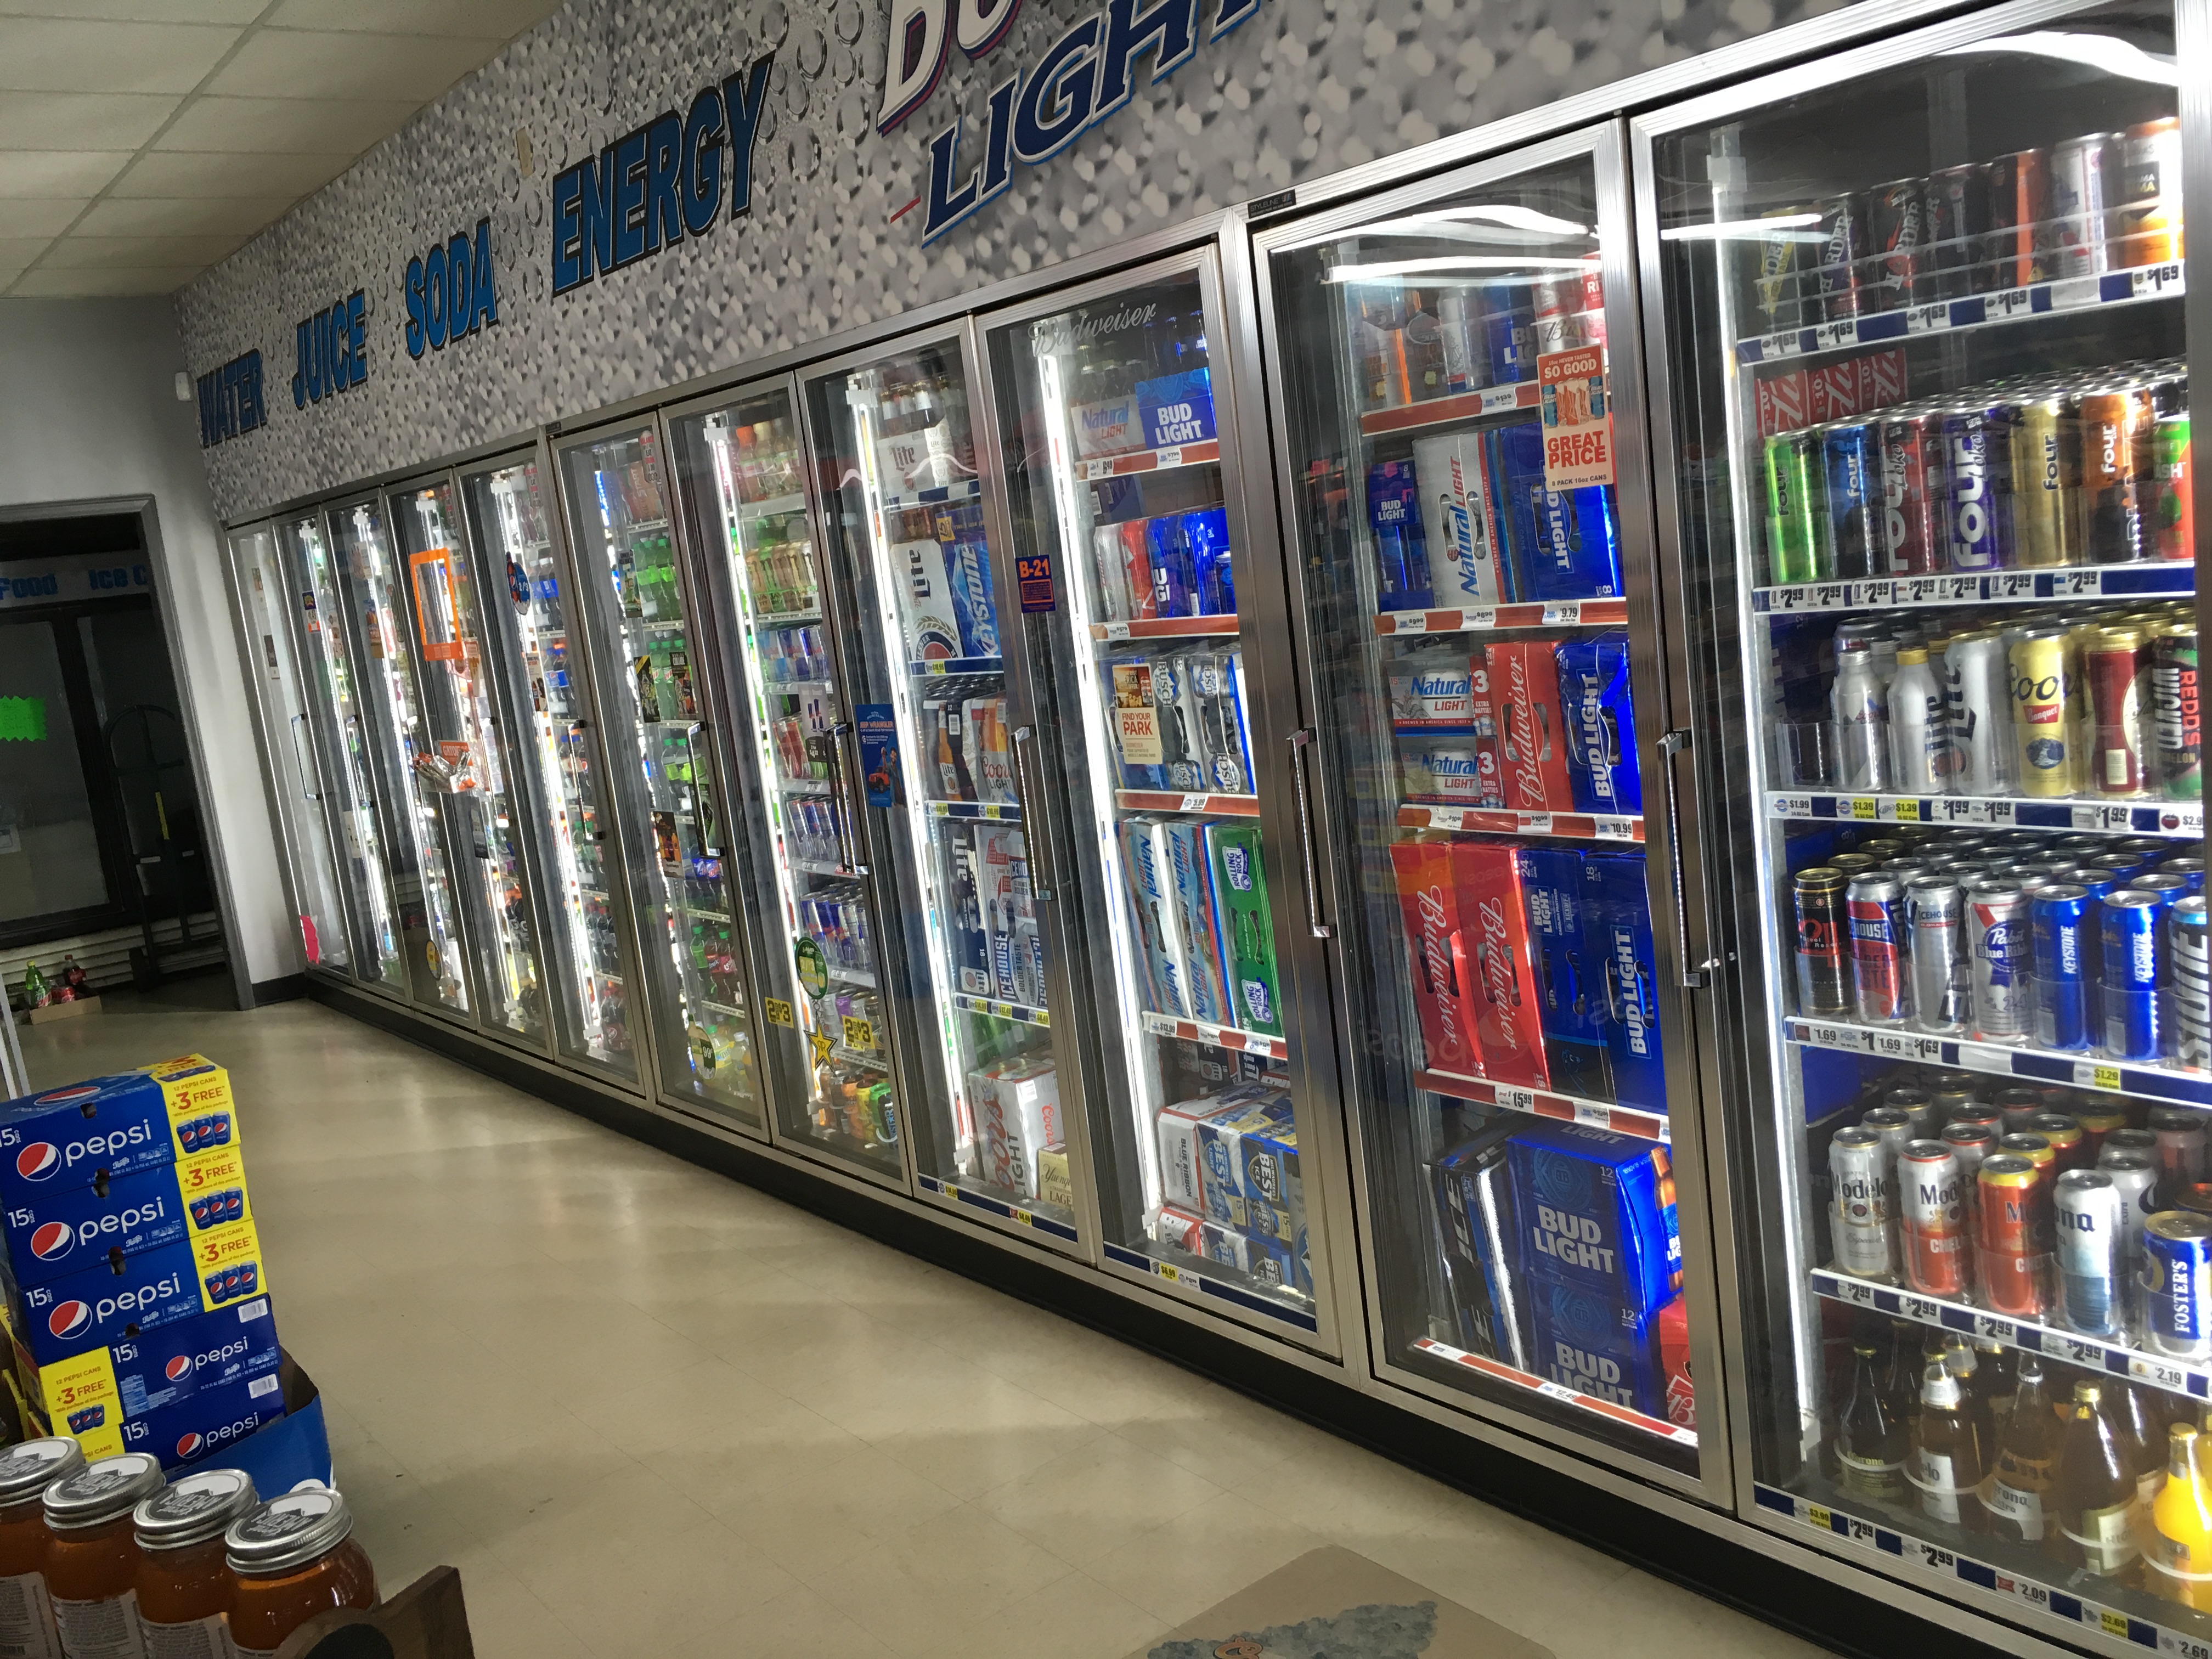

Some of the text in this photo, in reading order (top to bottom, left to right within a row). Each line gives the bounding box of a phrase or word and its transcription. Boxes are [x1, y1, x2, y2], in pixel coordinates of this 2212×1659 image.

[552, 50, 776, 298] ENERGY
[406, 217, 498, 360] SODA
[1028, 301, 1156, 357] Budweiser
[292, 289, 368, 410] JUICE
[1544, 358, 1597, 379] SO GOOD
[198, 347, 267, 449] WATER
[1081, 401, 1129, 431] Natural
[1157, 403, 1192, 425] BUD
[1101, 424, 1127, 439] LIGHT
[1155, 420, 1202, 444] LIGHT
[1548, 430, 1604, 452] GREAT
[891, 447, 915, 471] Lite
[1549, 445, 1606, 469] PRICE
[2043, 432, 2058, 491] four
[2101, 424, 2117, 473] four
[1847, 454, 1859, 497] four
[1378, 509, 1406, 521] LIGHT
[1381, 500, 1401, 512] BUD
[1450, 456, 1480, 597] Natural LIGHT
[1549, 514, 1570, 571] LIGHT
[89, 568, 128, 590] Ice
[909, 549, 932, 600] Lite
[1019, 558, 1049, 578] B-21
[0, 572, 59, 600] Food
[960, 545, 999, 656] KEYSTONE
[1158, 662, 1172, 707] BUSCH
[1204, 665, 1215, 698] BUSCH
[1411, 675, 1472, 696] Natural
[1474, 670, 1489, 693] 3
[1434, 700, 1466, 711] LIGHT
[2029, 706, 2058, 721] Banquet
[2152, 668, 2183, 749] WICKED
[2179, 670, 2201, 746] REDD'S
[1123, 721, 1153, 735] PARK
[1517, 654, 1544, 808] Budweiser
[1581, 673, 1610, 798] BUD LIGHT
[942, 763, 955, 776] Lite
[1178, 760, 1190, 789] BUSCH
[1217, 753, 1235, 794] BUSCH
[1422, 755, 1479, 775] Natural
[1480, 752, 1495, 774] 3
[1444, 778, 1475, 788] LIGHT
[1790, 800, 1810, 810] $1.99
[1853, 802, 1874, 811] $1.39
[1896, 803, 1917, 812] $1.39
[2182, 815, 2202, 826] $2.9
[952, 836, 968, 882] Lite
[1139, 834, 1161, 899] Natural
[1170, 830, 1187, 896] Natural
[1180, 839, 1189, 874] LIGHT
[1229, 852, 1240, 887] ROLLING
[1138, 857, 1148, 892] LIGHT
[1533, 895, 1543, 927] BUD
[1539, 889, 1553, 934] LIGHT
[1918, 909, 1957, 920] ICEHOUSE
[1976, 944, 2003, 958] Blue
[1990, 928, 2024, 945] Pabst
[2060, 926, 2078, 974] KEYSTONE
[995, 934, 1017, 1001] ICEHOUSE
[1417, 884, 1458, 1046] Budweiser
[2132, 932, 2154, 983] KEYSTONE
[975, 971, 985, 993] Lite
[1017, 966, 1025, 992] BOLDER
[1162, 959, 1184, 1018] Natural
[1192, 957, 1207, 1019] Natural
[1199, 967, 1210, 1000] LIGHT
[1479, 897, 1518, 1051] Budweiser
[1163, 979, 1174, 1009] LIGHT
[1248, 986, 1261, 1019] ROLLING
[1615, 931, 1646, 1054] BUD LIGHT
[2004, 995, 2027, 1011] 24
[181, 1081, 199, 1090] PEPSI
[200, 1076, 216, 1085] CANS
[2094, 1068, 2118, 1080] $1.29
[65, 1119, 151, 1167] pepsi
[213, 1153, 229, 1161] CANS
[1212, 1138, 1226, 1186] BEST
[1259, 1152, 1272, 1201] BEST
[1600, 1166, 1613, 1178] 12
[1183, 1164, 1192, 1198] RIBBON
[1831, 1173, 1886, 1199] Modelo
[8, 1208, 29, 1228] 15
[78, 1197, 165, 1246] pepsi
[1537, 1205, 1601, 1245] BUD
[209, 1232, 226, 1241] PEPSI
[228, 1227, 244, 1236] CANS
[1533, 1226, 1613, 1274] LIGHT
[1161, 1266, 1175, 1277] $6.99
[26, 1288, 47, 1307] 15
[96, 1272, 181, 1323] pepsi
[2174, 1259, 2189, 1334] FOSTER'S
[1622, 1308, 1635, 1321] 12
[112, 1344, 132, 1363] 15
[195, 1336, 249, 1370] pepsi
[1555, 1342, 1620, 1382] BUD
[64, 1373, 82, 1383] PEPSI
[83, 1366, 101, 1376] CANS
[1551, 1364, 1633, 1408] LIGHT
[57, 1387, 75, 1404] +3
[123, 1423, 144, 1441] 15
[206, 1412, 260, 1449] pepsi
[94, 1444, 112, 1454] CANS
[1809, 1507, 1830, 1522] $3.99
[2101, 1613, 2127, 1630] $2.69
